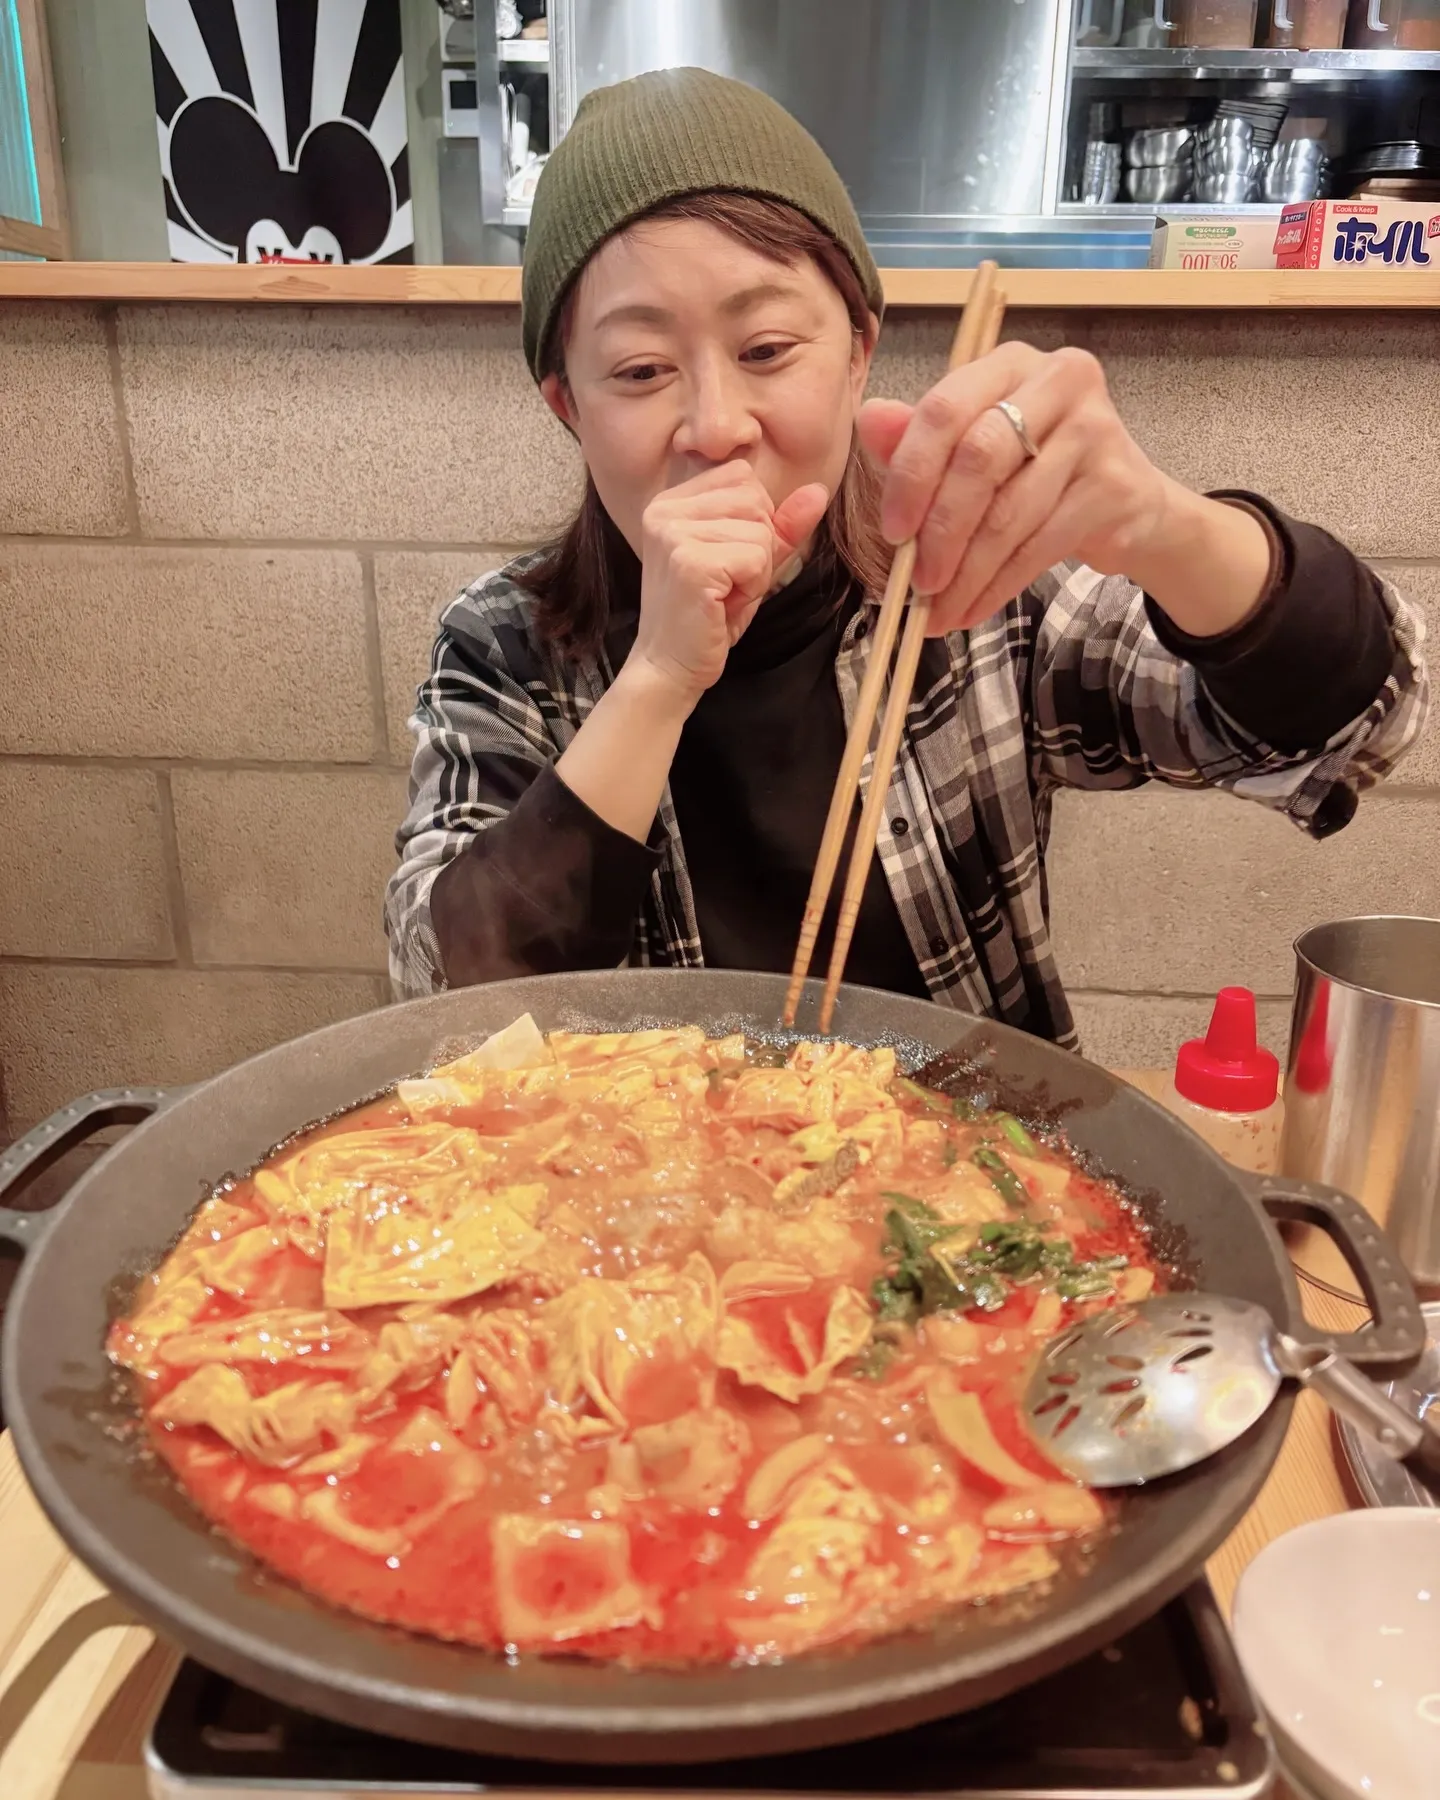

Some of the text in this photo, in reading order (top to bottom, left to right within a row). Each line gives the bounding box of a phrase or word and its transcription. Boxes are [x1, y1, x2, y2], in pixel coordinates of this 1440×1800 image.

[1336, 205, 1353, 213] Cook
[1359, 206, 1375, 214] Keep
[1310, 237, 1320, 269] COOK
[1333, 216, 1430, 264] ホイル
